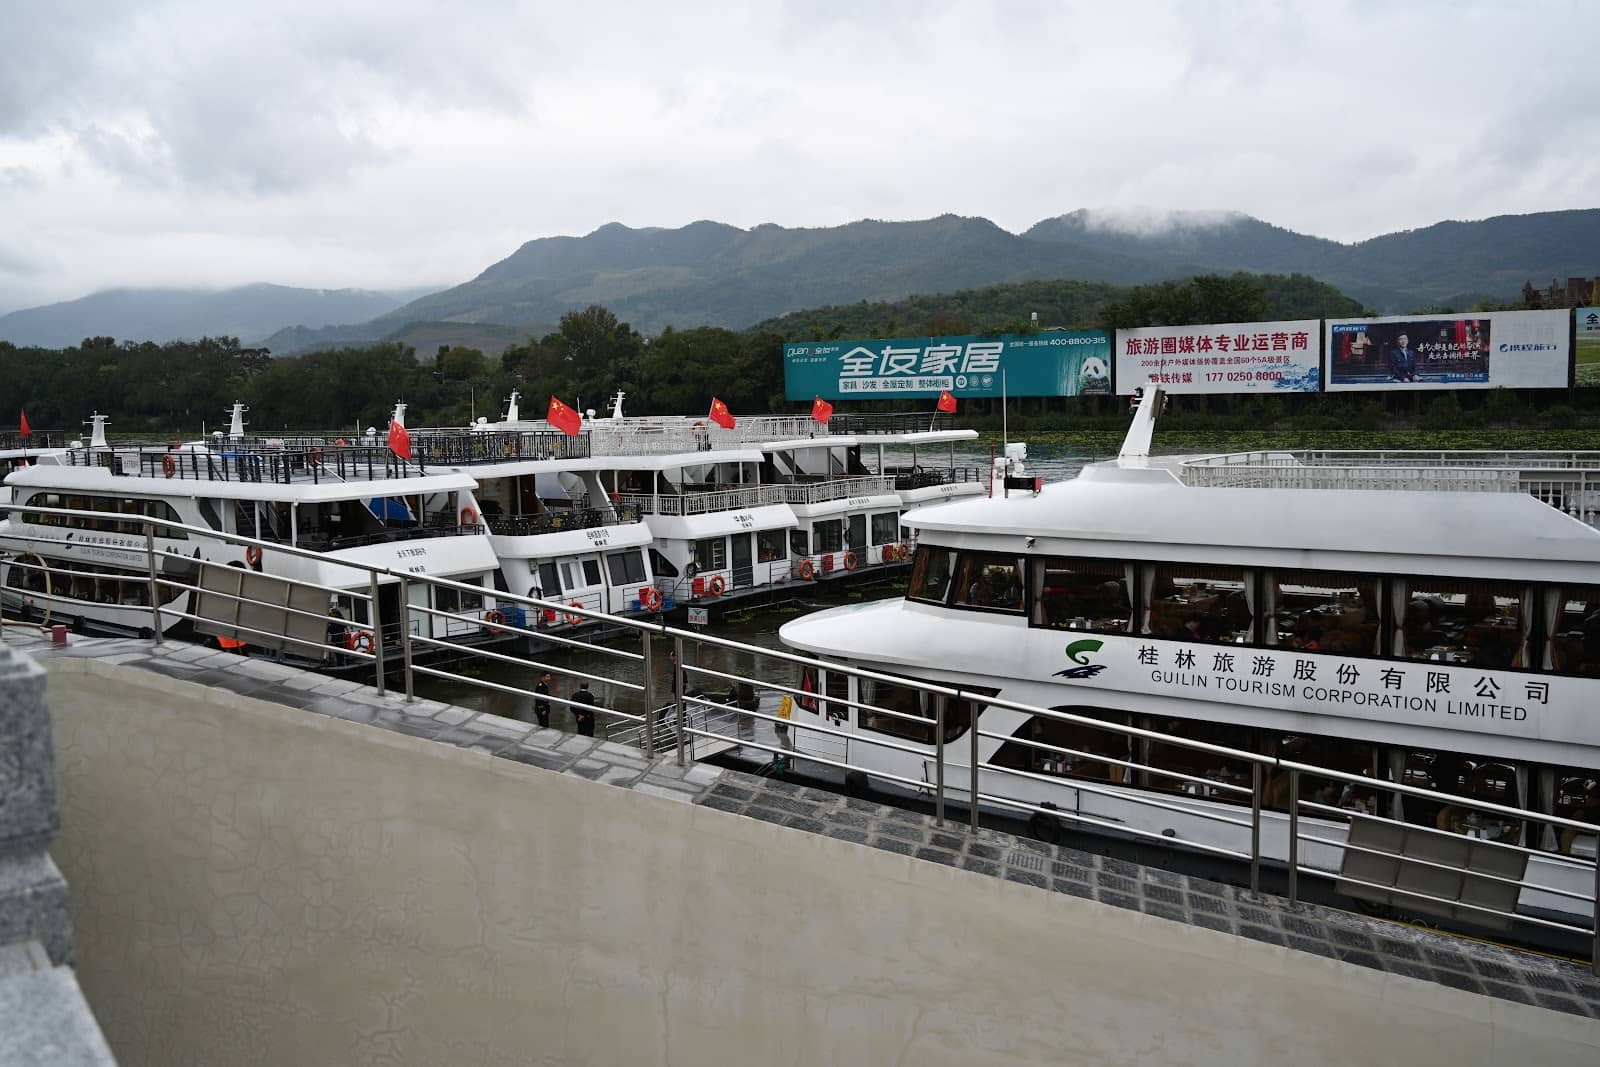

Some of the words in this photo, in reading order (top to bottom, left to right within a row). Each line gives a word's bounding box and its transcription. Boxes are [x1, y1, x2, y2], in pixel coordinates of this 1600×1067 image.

[1049, 336, 1106, 346] 400-8800-315
[1126, 332, 1309, 355] 旅游圈媒体专业运营商
[837, 341, 1004, 377] 全友家居
[862, 380, 877, 390] 沙发
[1206, 372, 1224, 382] 177
[1228, 371, 1253, 382] 0250
[1137, 645, 1550, 704] 桂林旅游股份有限公司
[1151, 669, 1207, 688] GUILIN
[1216, 677, 1296, 698] TOURISM
[1302, 686, 1438, 713] CORPORATION
[1447, 699, 1528, 722] LIMITED
